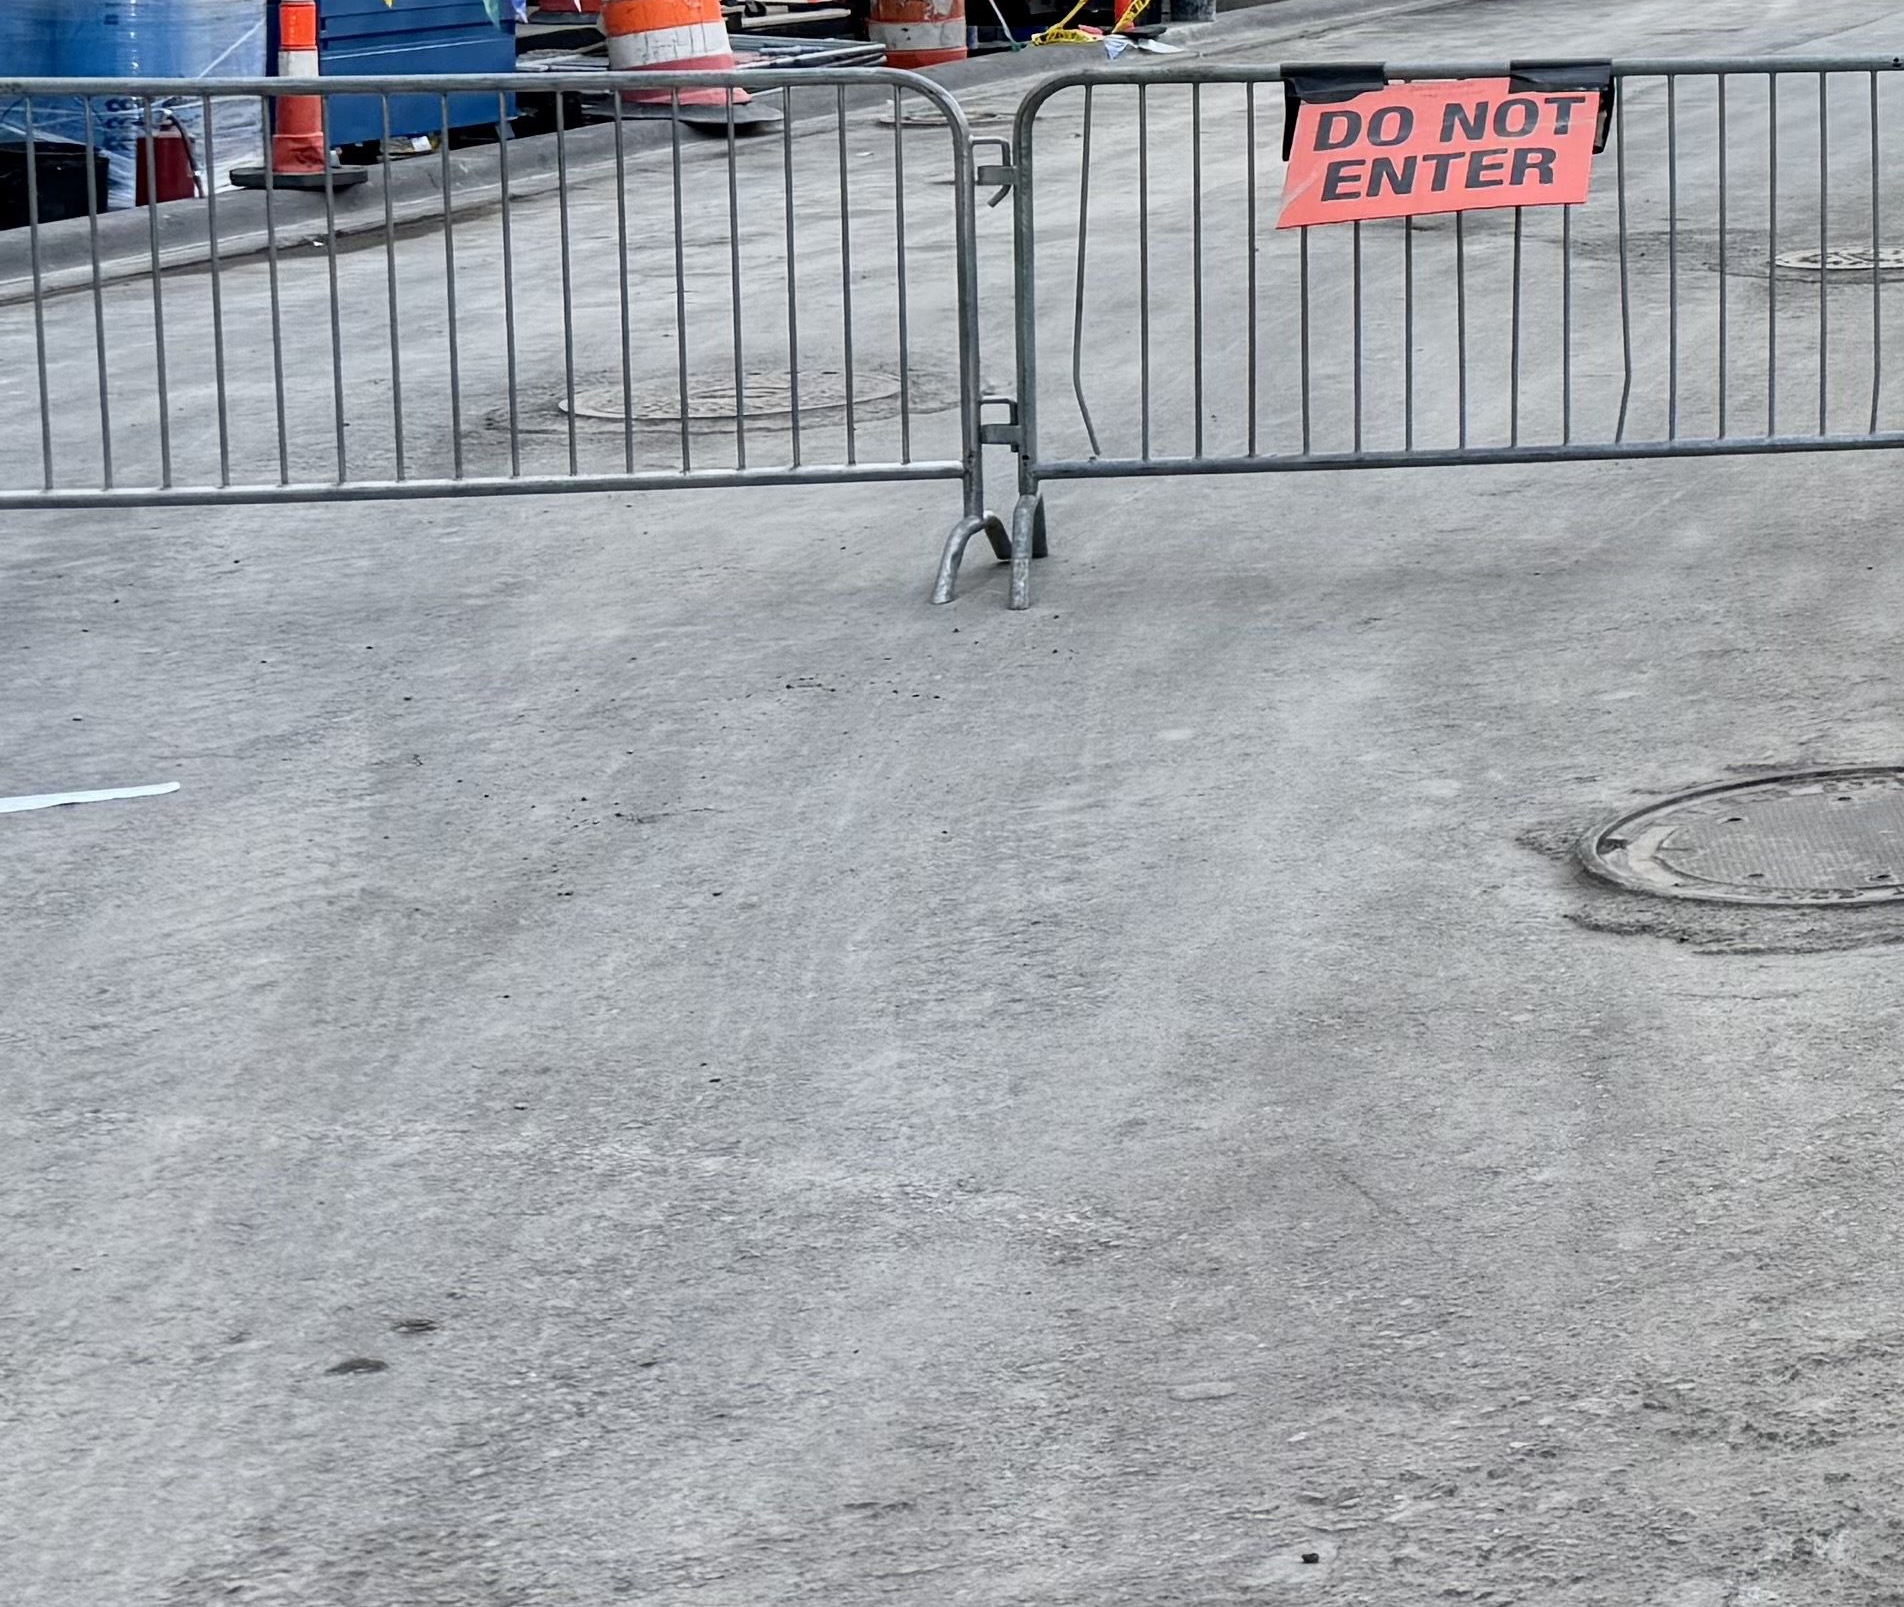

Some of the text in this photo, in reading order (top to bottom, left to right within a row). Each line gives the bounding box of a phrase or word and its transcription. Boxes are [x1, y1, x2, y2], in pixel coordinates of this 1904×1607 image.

[1313, 96, 1586, 152] DO NOT
[1321, 147, 1557, 202] ENTER
